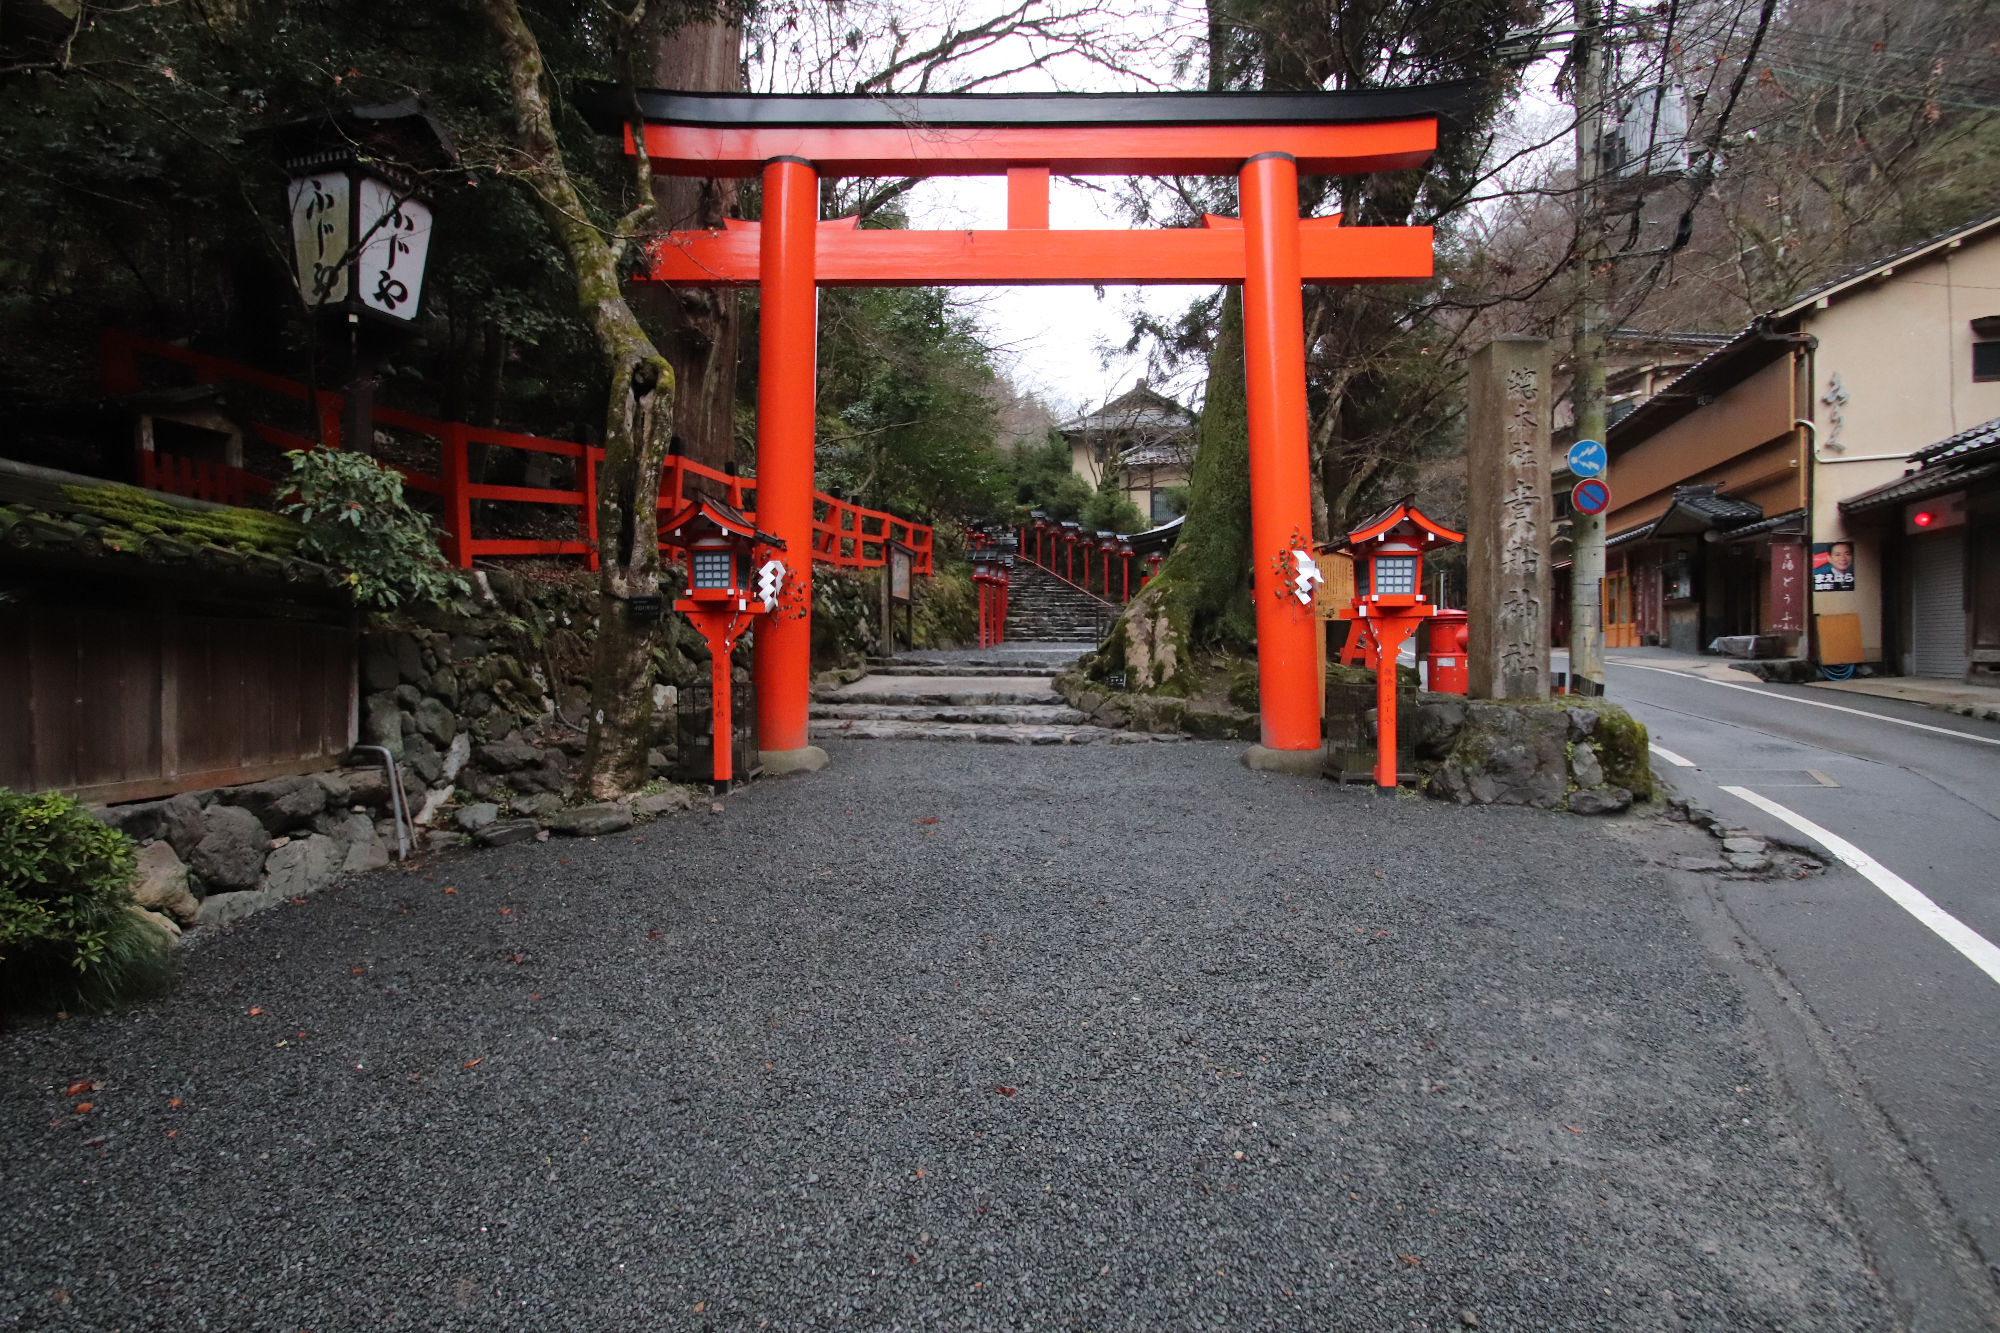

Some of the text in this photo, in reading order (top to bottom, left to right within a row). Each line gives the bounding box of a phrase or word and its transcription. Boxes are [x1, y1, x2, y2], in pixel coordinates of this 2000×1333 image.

[306, 180, 338, 298] ふじや
[373, 202, 414, 310] ふじや
